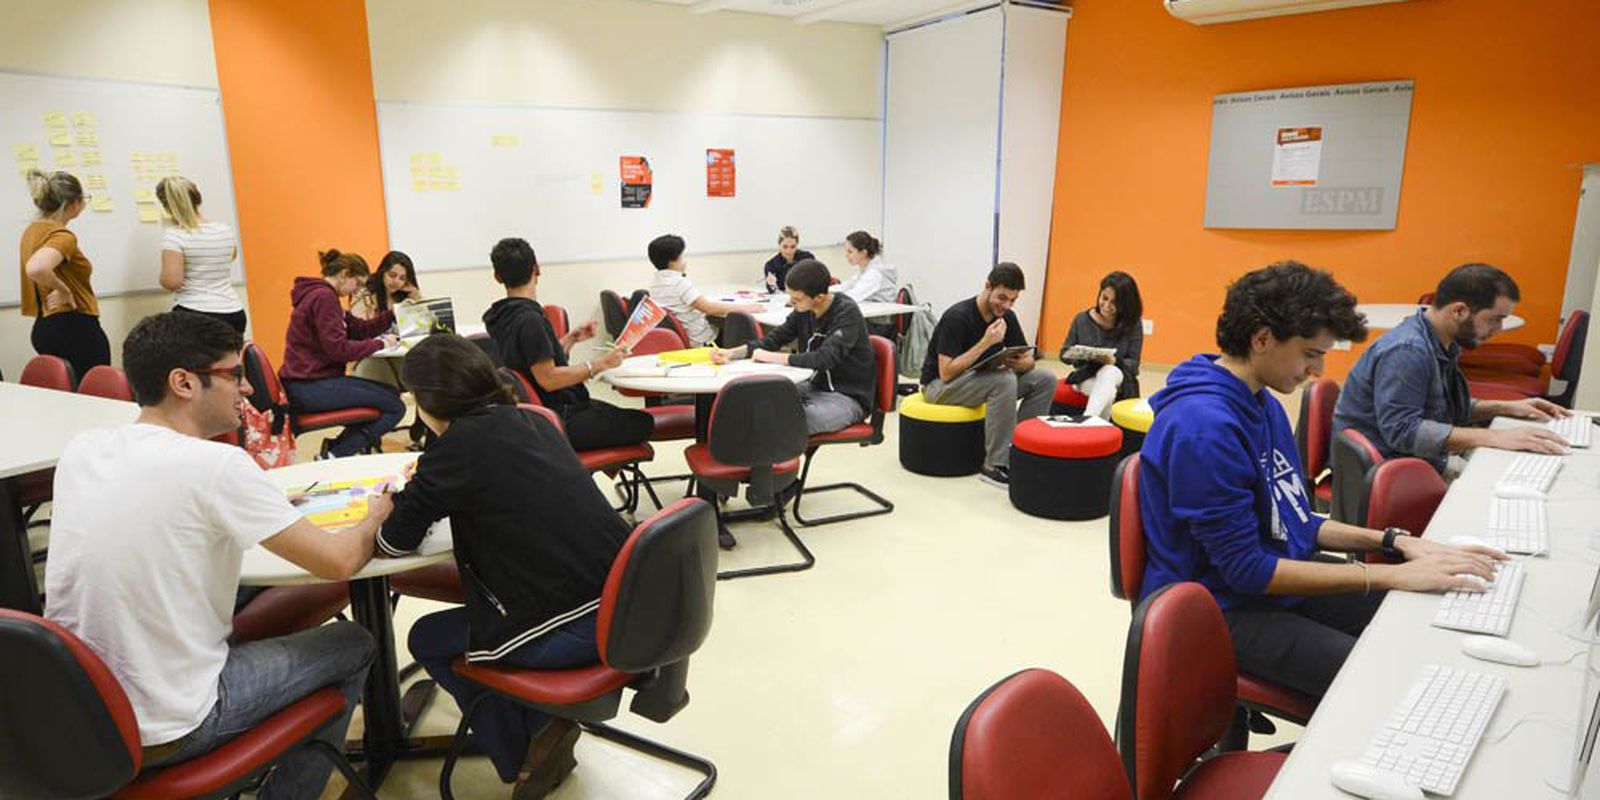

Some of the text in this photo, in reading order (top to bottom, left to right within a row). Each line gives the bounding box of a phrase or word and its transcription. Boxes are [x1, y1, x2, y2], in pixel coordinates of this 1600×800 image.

[1280, 91, 1304, 99] Avisos
[1305, 89, 1331, 98] Gerais
[1335, 87, 1360, 96] Avisos
[1362, 85, 1389, 94] Gerais
[1304, 189, 1377, 213] ESPM
